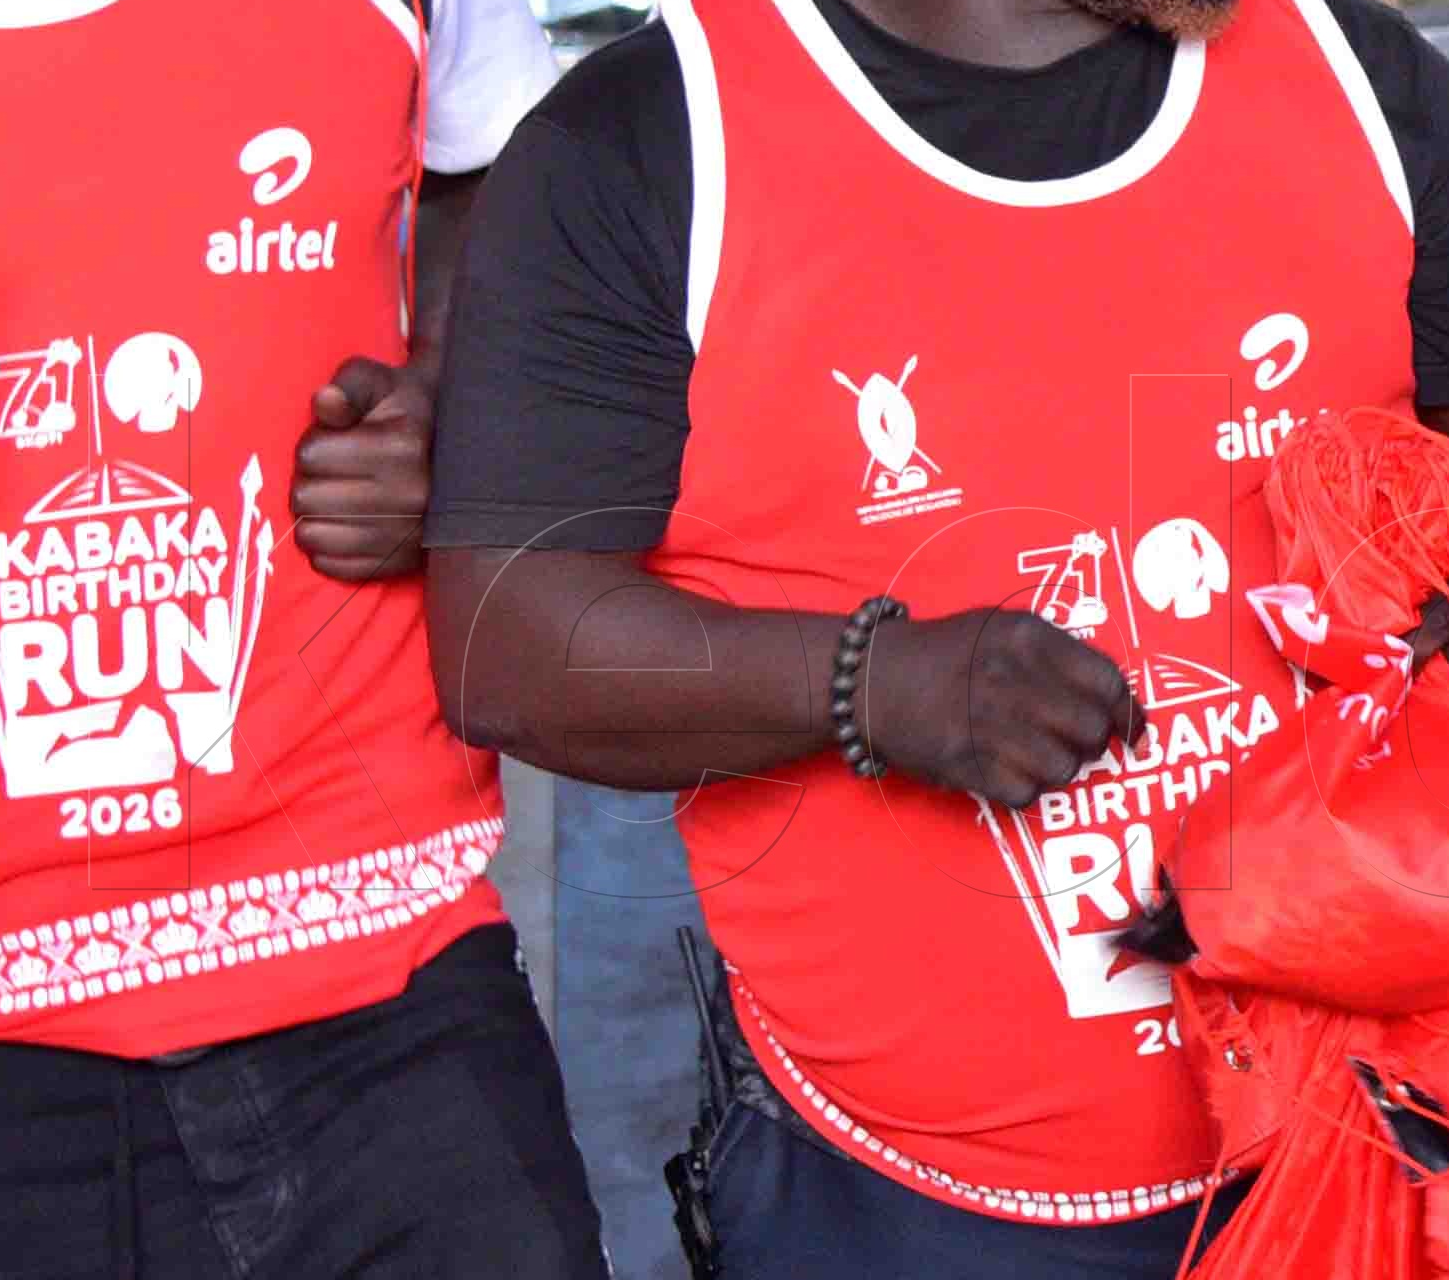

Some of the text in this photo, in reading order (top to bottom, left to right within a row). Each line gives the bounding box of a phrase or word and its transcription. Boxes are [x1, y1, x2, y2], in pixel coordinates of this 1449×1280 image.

[205, 218, 338, 275] airtel
[1216, 406, 1328, 462] airt
[1071, 693, 1279, 782] ABAKA
[59, 787, 182, 839] 2026
